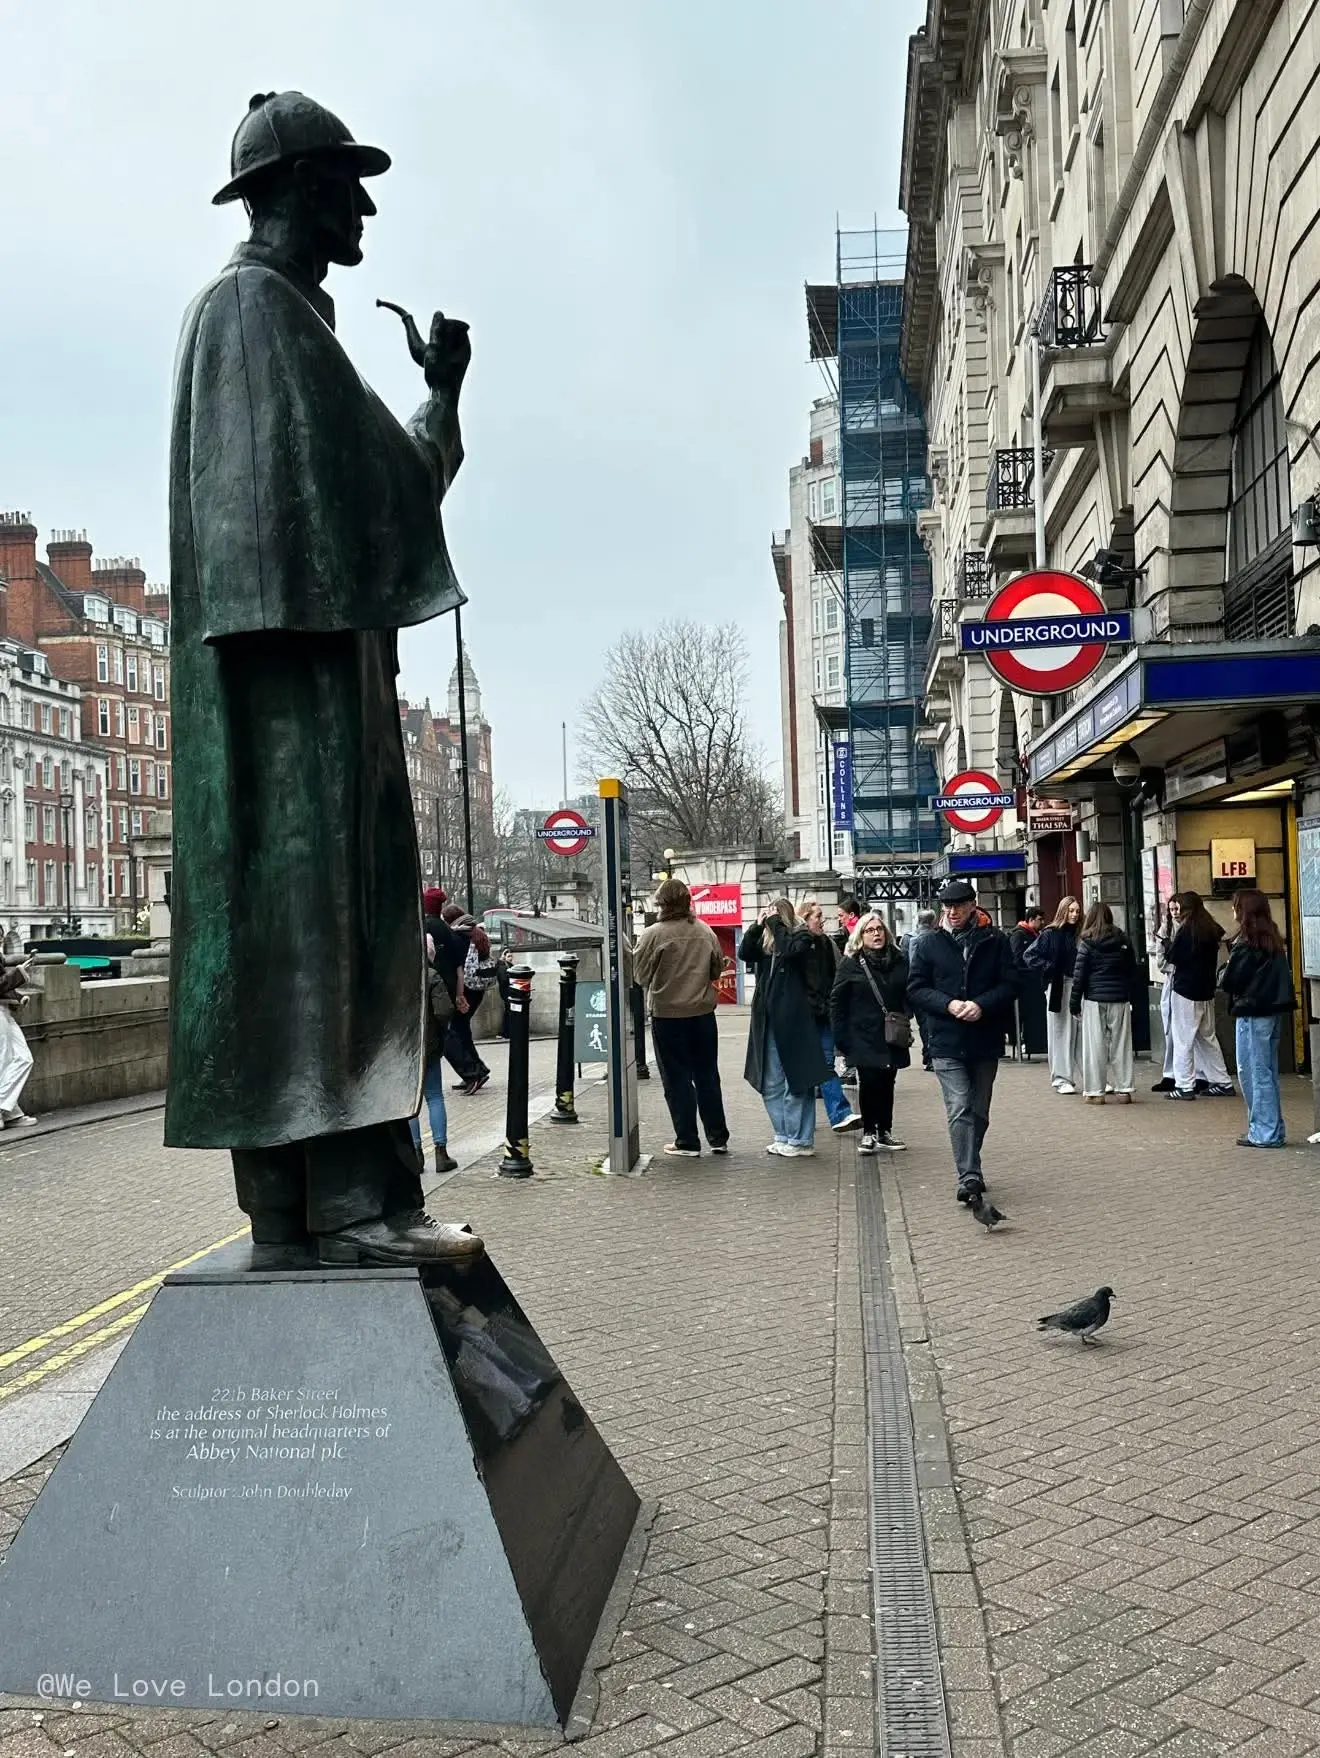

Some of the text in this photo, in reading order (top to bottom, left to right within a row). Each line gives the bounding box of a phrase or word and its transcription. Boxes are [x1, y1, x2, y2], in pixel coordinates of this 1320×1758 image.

[971, 621, 1120, 645] UNDERGROUND
[936, 795, 1012, 808] UNDERGROUND
[1054, 821, 1068, 829] SPA
[537, 829, 592, 838] UNDERGROUND
[1221, 862, 1247, 877] LFB
[251, 1388, 294, 1401] Baker
[296, 1387, 339, 1401] Street
[156, 1403, 388, 1421] the address of Sherlock Holmes
[150, 1423, 392, 1444] is at the original headquarters of
[185, 1441, 347, 1464] Abbey National plc
[238, 1483, 272, 1498] John
[277, 1482, 353, 1501] Doubleday
